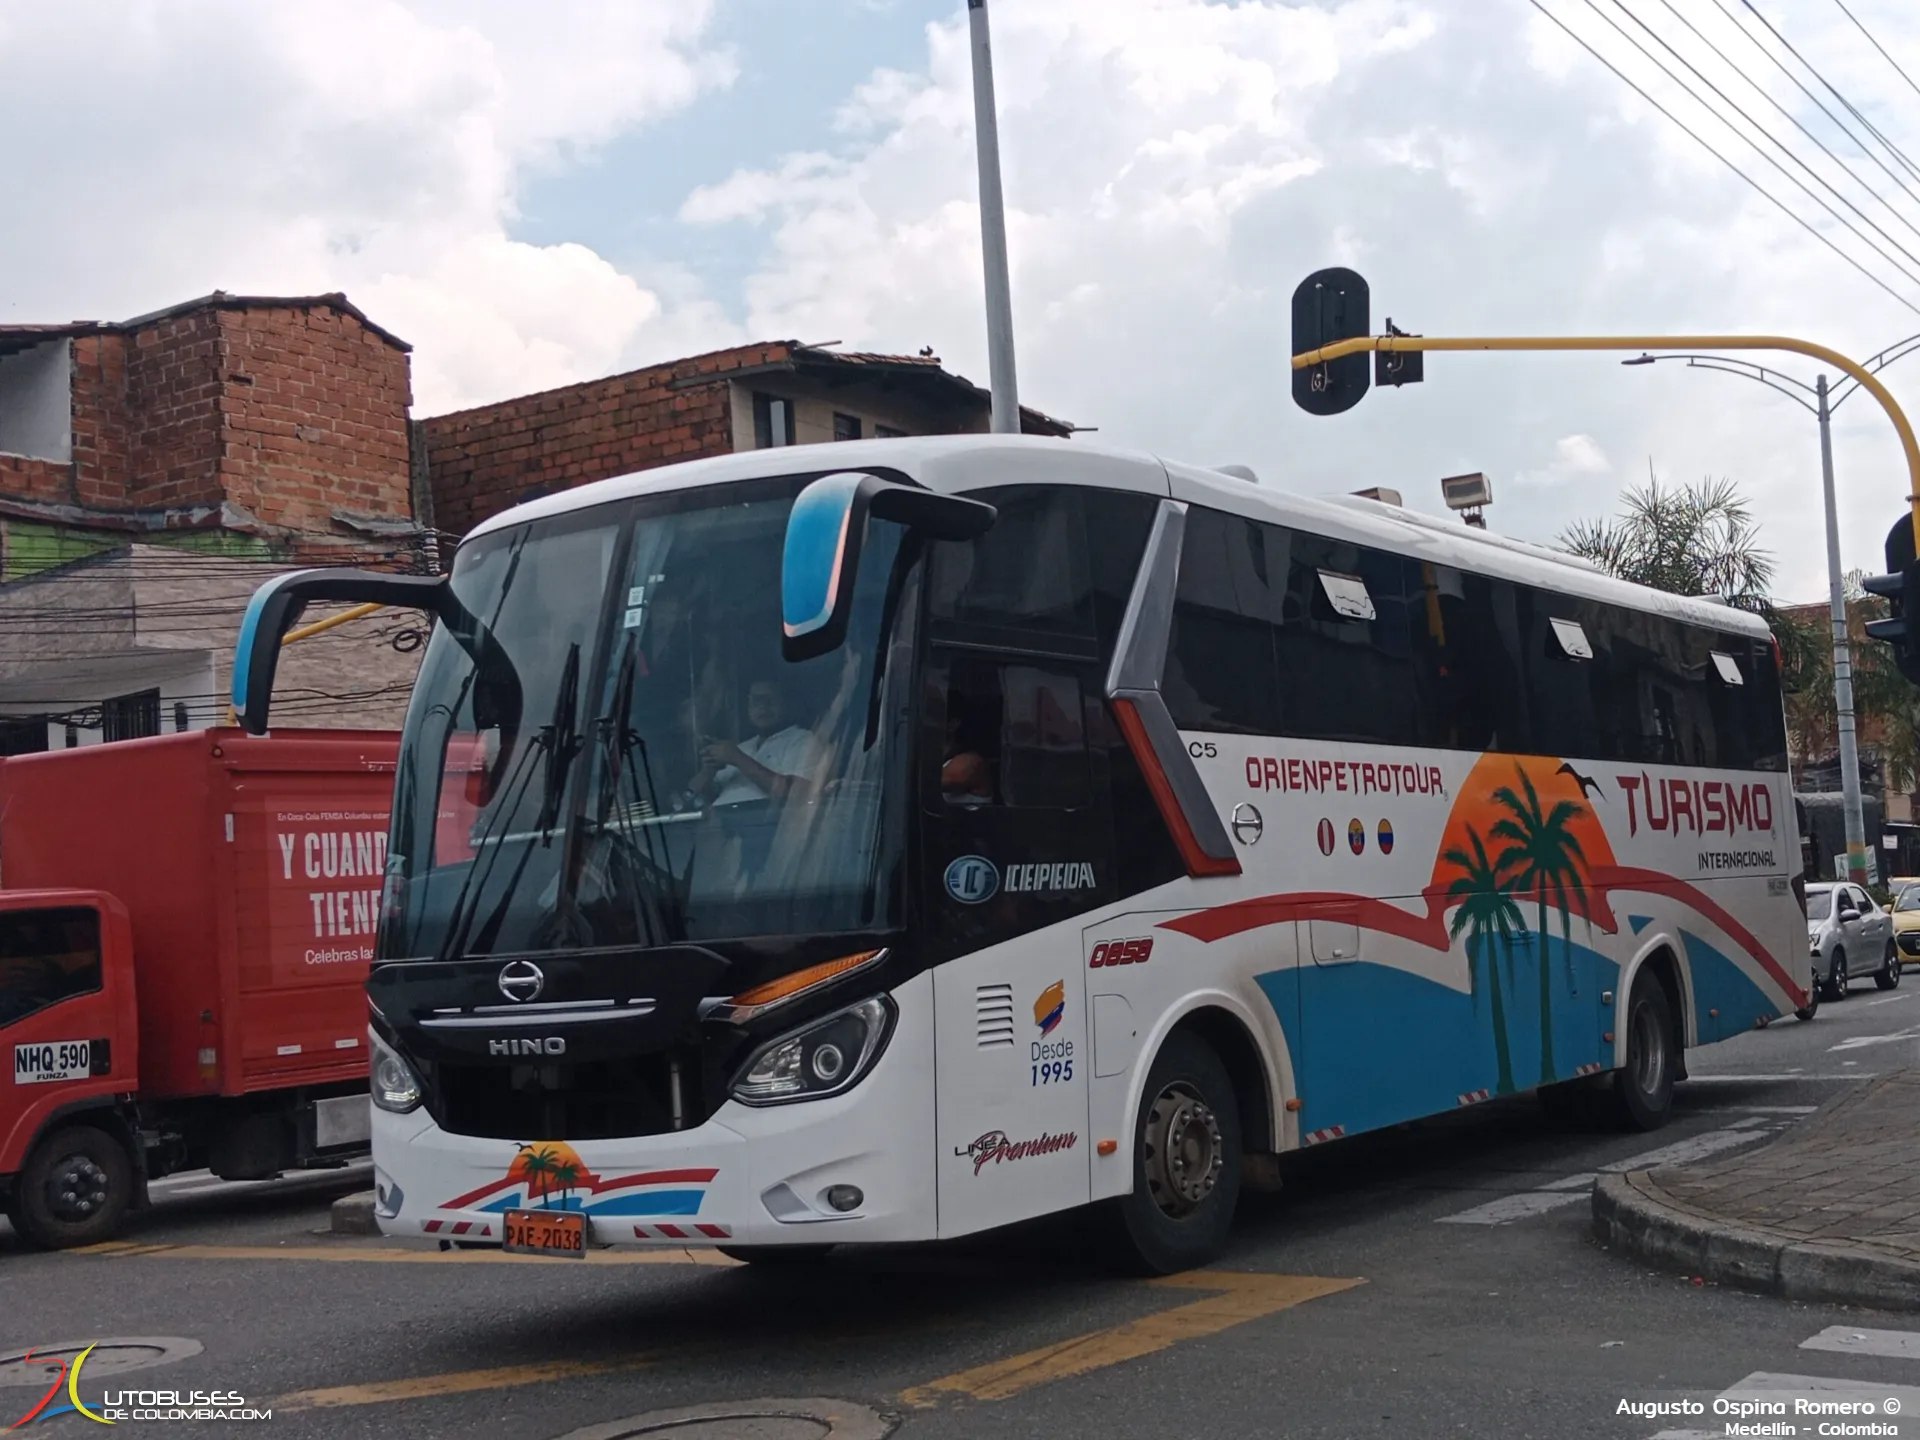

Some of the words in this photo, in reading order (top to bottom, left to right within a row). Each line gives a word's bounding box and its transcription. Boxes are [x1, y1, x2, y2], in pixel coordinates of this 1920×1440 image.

[1189, 741, 1217, 759] C5
[1245, 756, 1443, 797] ORIENPETROTOUR
[1616, 769, 1772, 839] TURISMO
[278, 833, 295, 879] Y
[1698, 850, 1776, 871] INTERNACIONAL
[305, 948, 359, 965] Celebras
[1089, 936, 1154, 969] 0858
[16, 1046, 54, 1073] NHQ
[59, 1043, 89, 1070] 590
[489, 1037, 566, 1055] HINO
[1031, 1037, 1074, 1062] Desde
[37, 1071, 68, 1080] FUNZA
[1032, 1060, 1073, 1087] 1995
[973, 1130, 1078, 1177] Premium
[506, 1225, 582, 1251] PAE-2038
